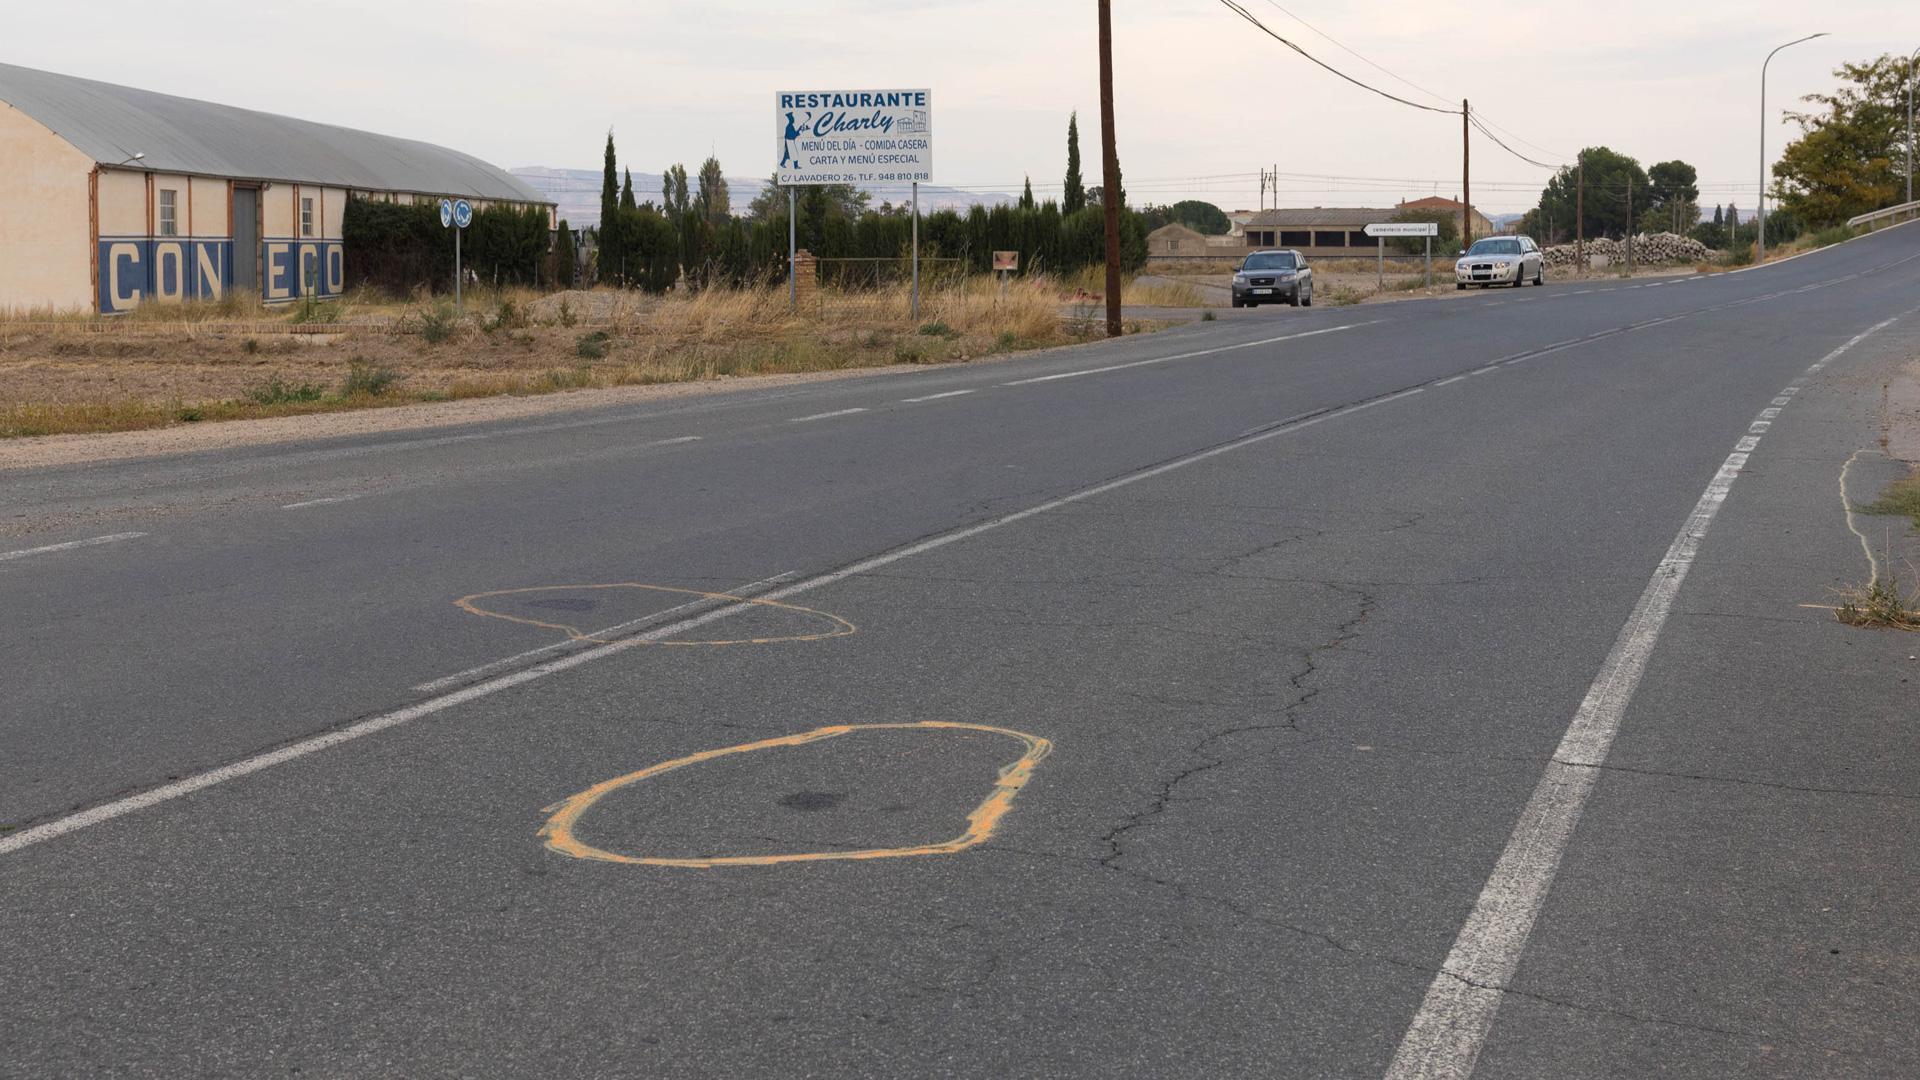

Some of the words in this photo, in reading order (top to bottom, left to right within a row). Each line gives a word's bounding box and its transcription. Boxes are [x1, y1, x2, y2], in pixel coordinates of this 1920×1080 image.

[781, 92, 926, 109] RESTAURANTE
[813, 109, 895, 137] Charly
[801, 138, 825, 151] MENÚ
[826, 140, 842, 151] DEL
[843, 138, 857, 151] DÍA
[864, 139, 897, 150] COMIDA
[897, 139, 928, 150] CASERA
[809, 155, 839, 165] CARTA
[840, 155, 846, 164] Y
[848, 152, 876, 164] MENÚ
[877, 154, 920, 164] ESPECIAL
[781, 173, 792, 182] C/
[793, 173, 841, 182] LAVADERO
[858, 173, 877, 181] TLF.
[878, 172, 895, 181] 948
[897, 172, 912, 180] 810
[914, 172, 929, 180] 818
